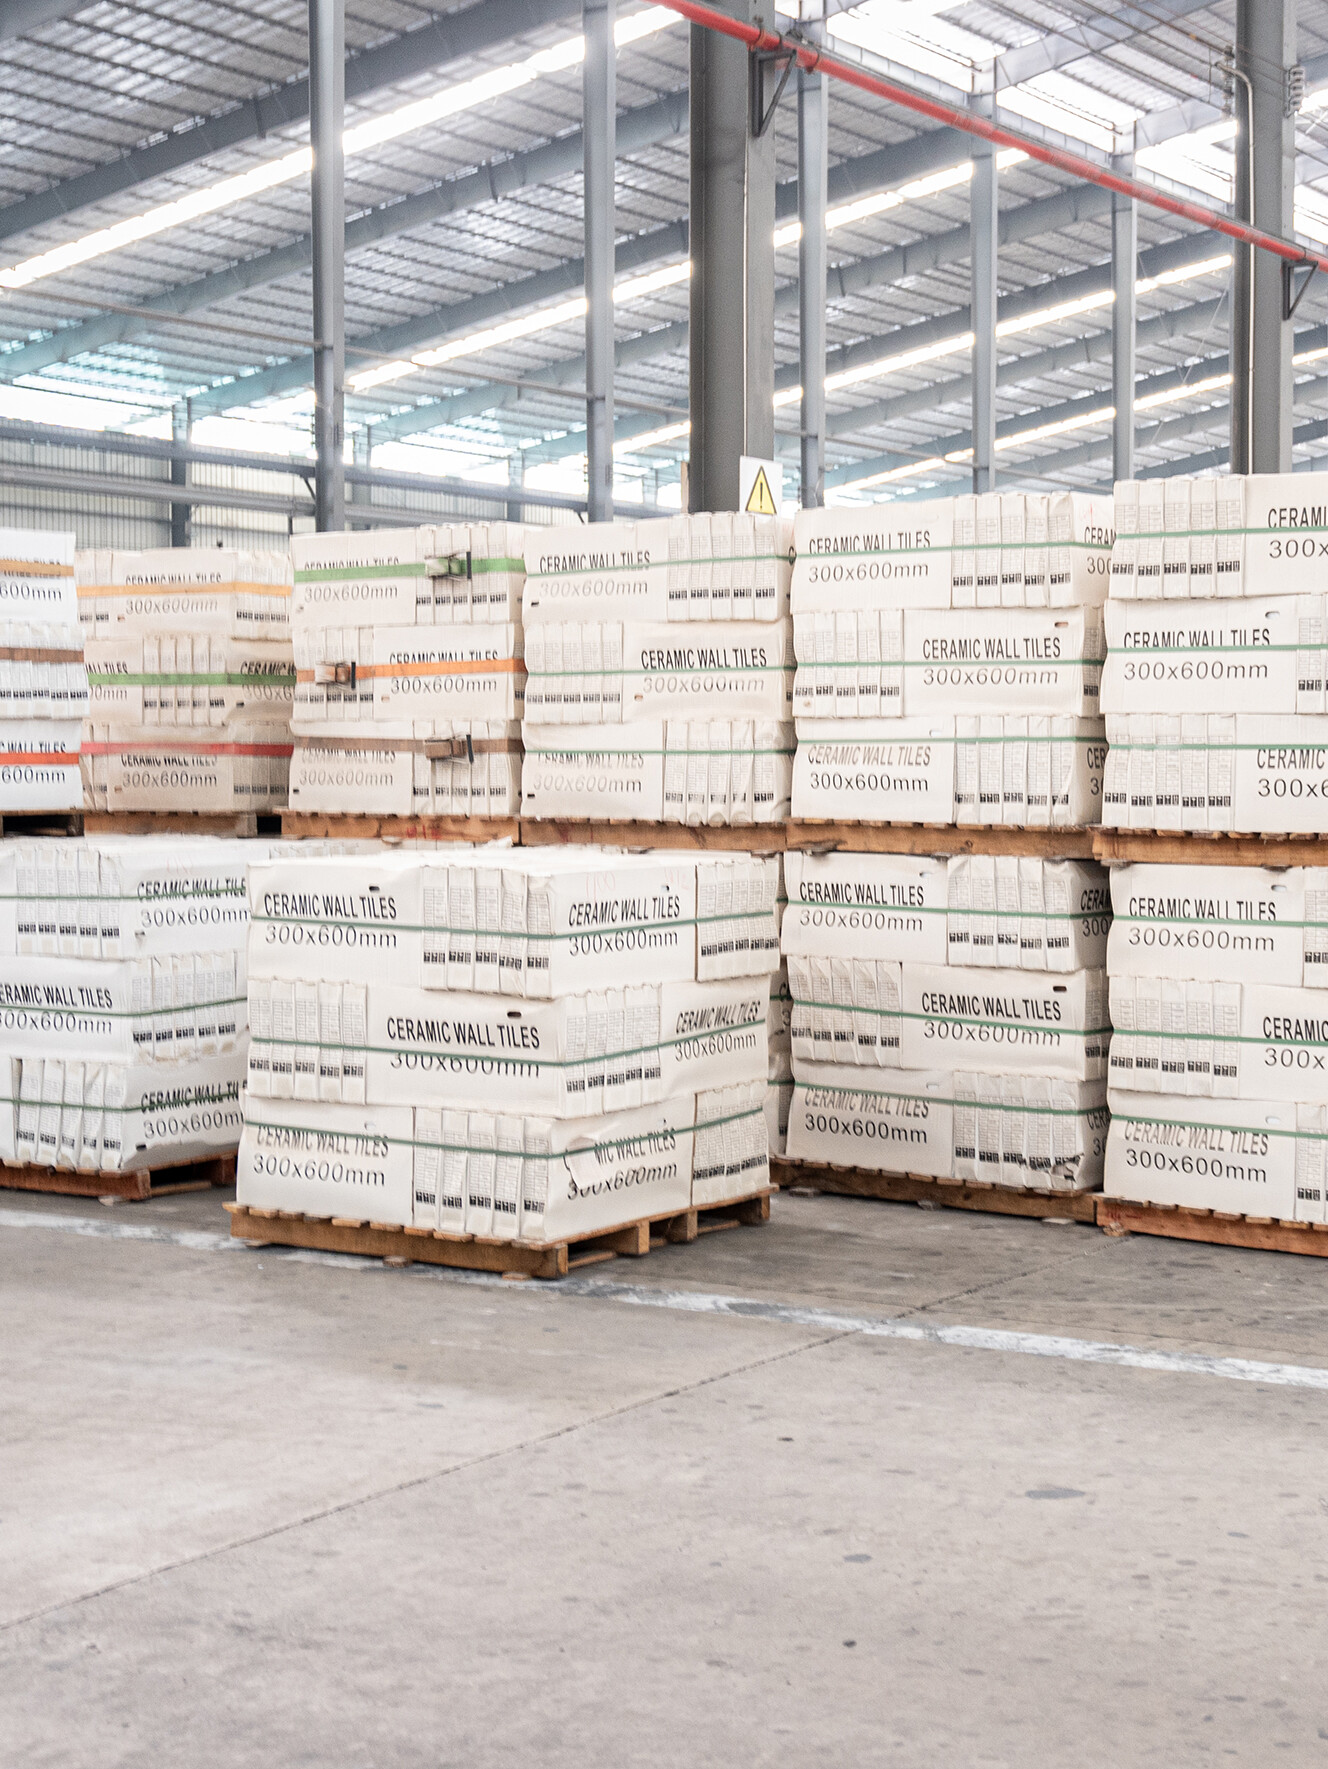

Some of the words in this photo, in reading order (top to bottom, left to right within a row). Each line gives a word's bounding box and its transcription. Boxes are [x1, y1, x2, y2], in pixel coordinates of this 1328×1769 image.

[809, 535, 860, 554] CERAMIC
[897, 530, 930, 549] TILES
[540, 554, 586, 574] CERAMIC
[621, 550, 650, 571] TILES
[809, 562, 929, 583] 300x600mm
[923, 638, 981, 659] CERAMIC
[984, 638, 1020, 658] WALL
[1023, 637, 1061, 658] TILES
[1124, 631, 1186, 648] CERAMIC
[641, 650, 694, 670] CERAMIC
[697, 649, 731, 669] WALL
[733, 648, 767, 668] TILES
[1124, 661, 1268, 681] 300x600mm
[391, 675, 497, 694] 300x600mm
[643, 675, 764, 693] 300x600mm
[923, 667, 1058, 687] 300x600mm
[808, 745, 859, 766] CERAMIC
[862, 746, 893, 766] WALL
[898, 745, 931, 766] TILES
[1256, 749, 1326, 769] CERAMIC
[122, 770, 217, 789] 300x600mm
[810, 773, 928, 792] 300x600mm
[264, 893, 320, 917] CERAMIC
[322, 894, 358, 918] WALL
[359, 896, 397, 920] TILES
[799, 882, 852, 904] CERAMIC
[854, 884, 888, 905] WALL
[889, 885, 924, 907] TILES
[569, 900, 618, 927] CERAMIC
[621, 897, 648, 921] WALL
[652, 896, 680, 919] TILES
[800, 909, 924, 931] 300x600mm
[1129, 897, 1190, 920] CERAMIC
[1194, 899, 1231, 921] WALL
[1236, 901, 1276, 922] TILES
[265, 923, 397, 948] 300x600mm
[569, 929, 678, 957] 300x600mm
[1128, 926, 1275, 952] 300x600mm
[43, 985, 78, 1007] WALL
[78, 986, 113, 1009] TILES
[922, 992, 981, 1016] CERAMIC
[983, 996, 1022, 1020] WALL
[1023, 1000, 1062, 1021] TILES
[675, 1010, 712, 1035] CERAMIC
[713, 1005, 735, 1028] WALL
[737, 1000, 761, 1024] TILES
[387, 1016, 451, 1044] CERAMIC
[453, 1020, 495, 1047] WALL
[497, 1025, 540, 1049] TILES
[923, 1020, 1061, 1047] 300x600mm
[674, 1033, 757, 1063] 300x600mm
[803, 1087, 855, 1112] CERAMIC
[857, 1092, 893, 1116] WALL
[895, 1094, 930, 1120] TILES
[257, 1125, 313, 1151] CERAMIC
[317, 1132, 350, 1155] WALL
[355, 1134, 389, 1158] TILES
[804, 1114, 928, 1144] 300x600mm
[1124, 1120, 1187, 1148] CERAMIC
[1189, 1125, 1226, 1151] WALL
[1229, 1129, 1269, 1157] TILES
[253, 1153, 385, 1187] 300x600mm
[1125, 1148, 1268, 1184] 300x600mm
